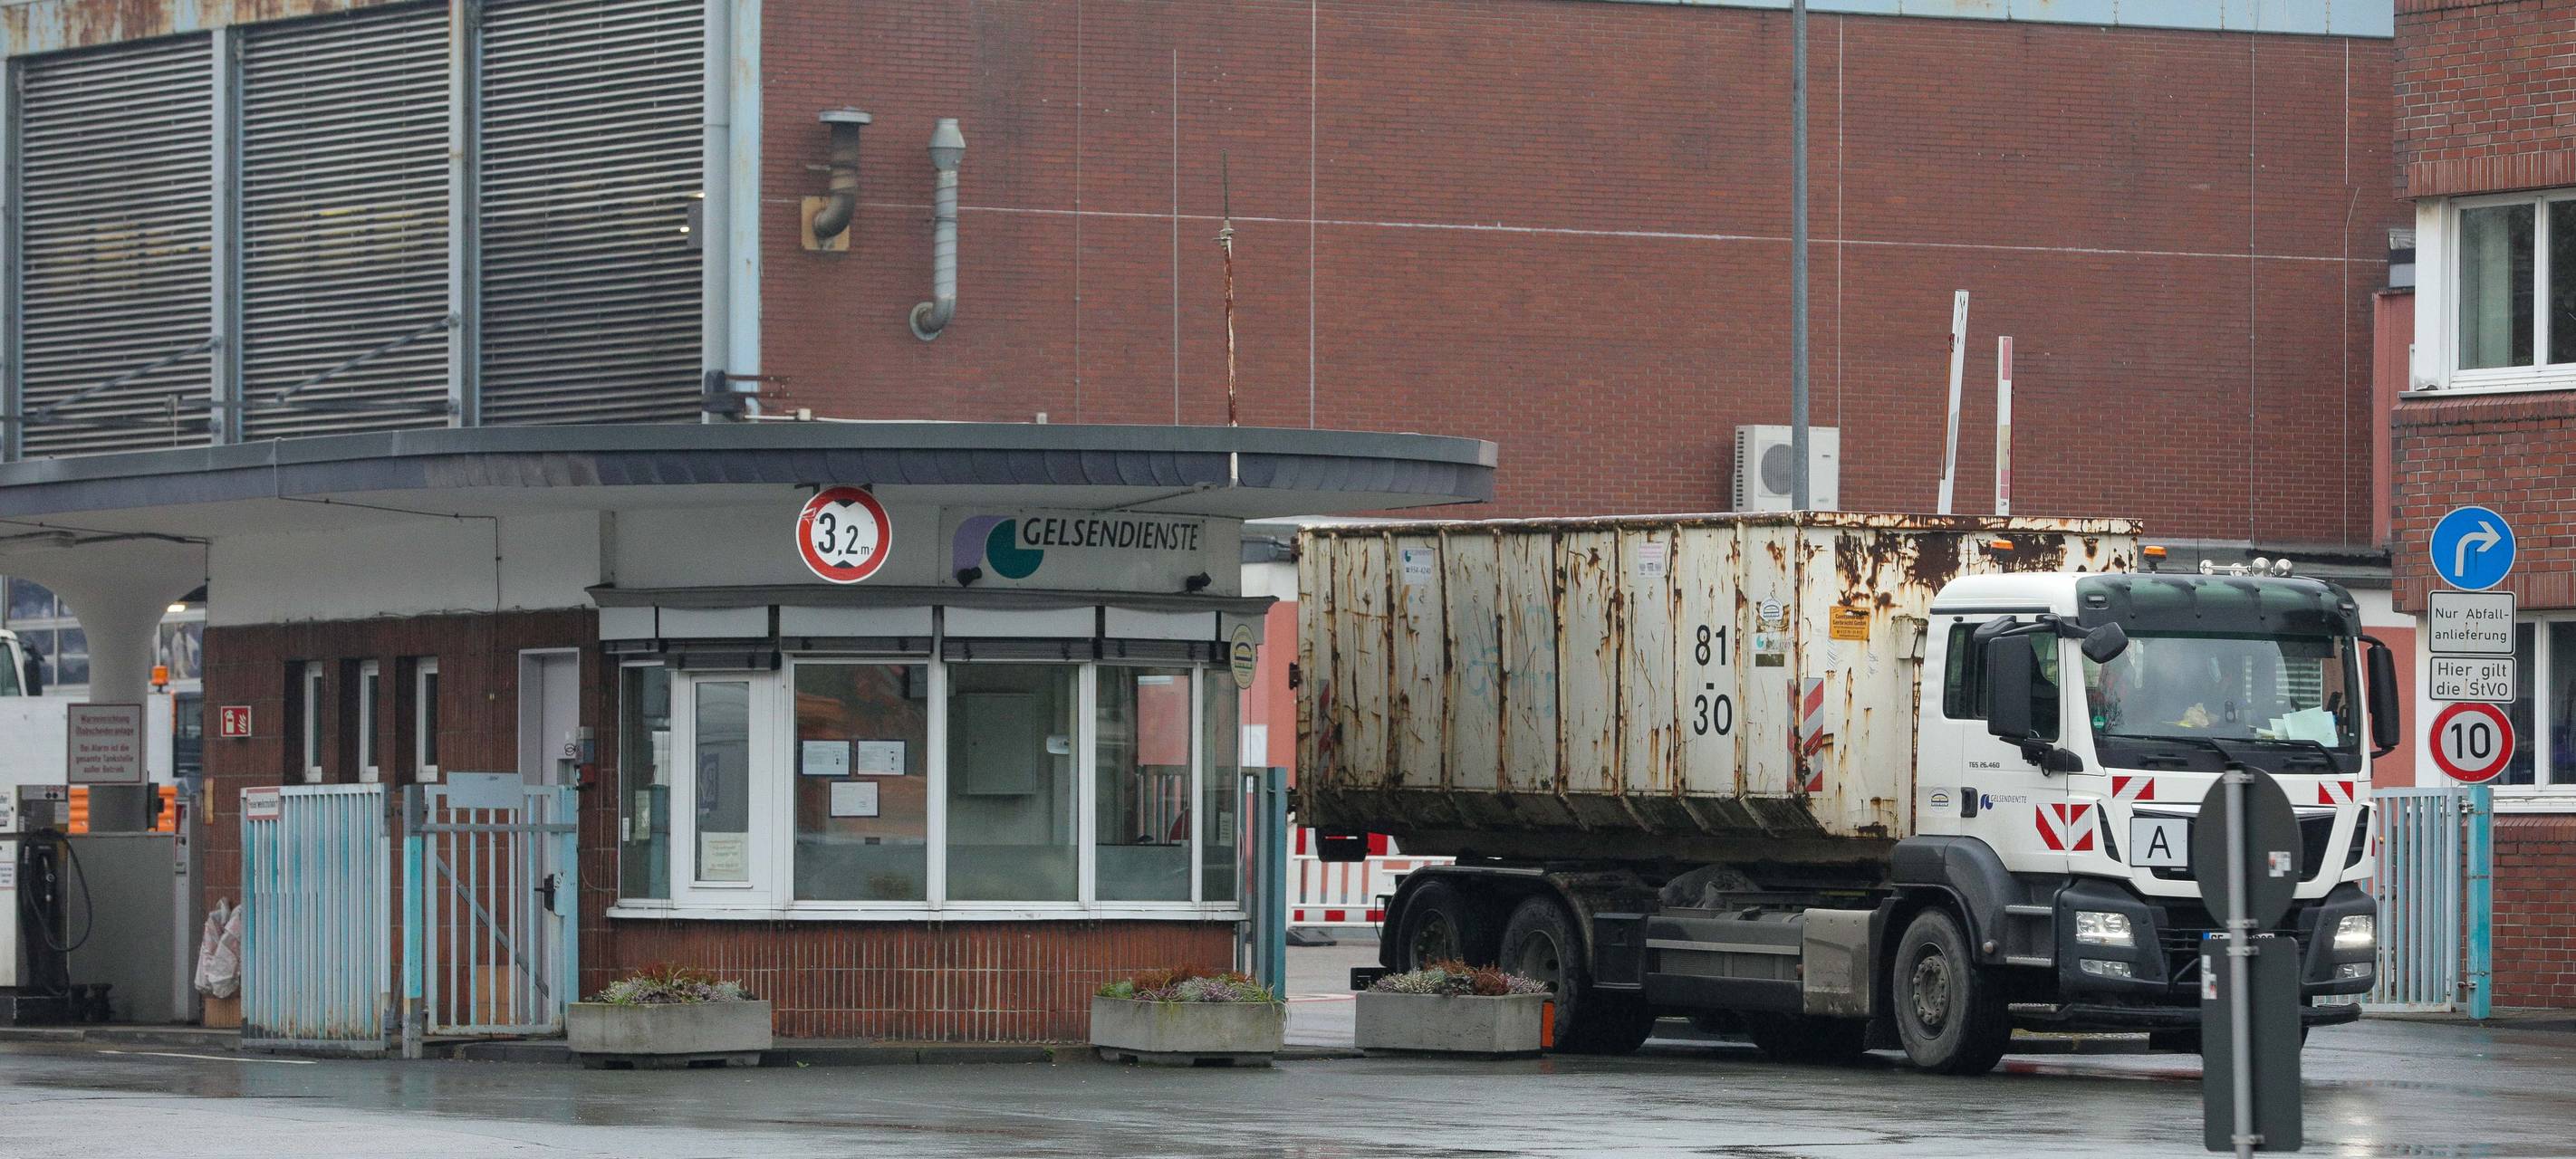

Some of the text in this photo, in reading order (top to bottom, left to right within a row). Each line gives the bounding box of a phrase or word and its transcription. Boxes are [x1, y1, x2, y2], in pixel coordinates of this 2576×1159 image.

[1023, 517, 1198, 551] GELSENDIENSTE
[2435, 608, 2509, 619] Nur Abfall-
[2435, 628, 2507, 644] anlieferung
[1695, 625, 1726, 666] 81
[2437, 662, 2507, 680] Hier gilt
[2437, 681, 2508, 696] die StVO
[1693, 694, 1732, 735] 30
[2451, 722, 2491, 759] 10
[103, 754, 134, 762] Tankstelle
[1991, 794, 2027, 803] GELSENDIENSTE
[2147, 825, 2172, 859] A
